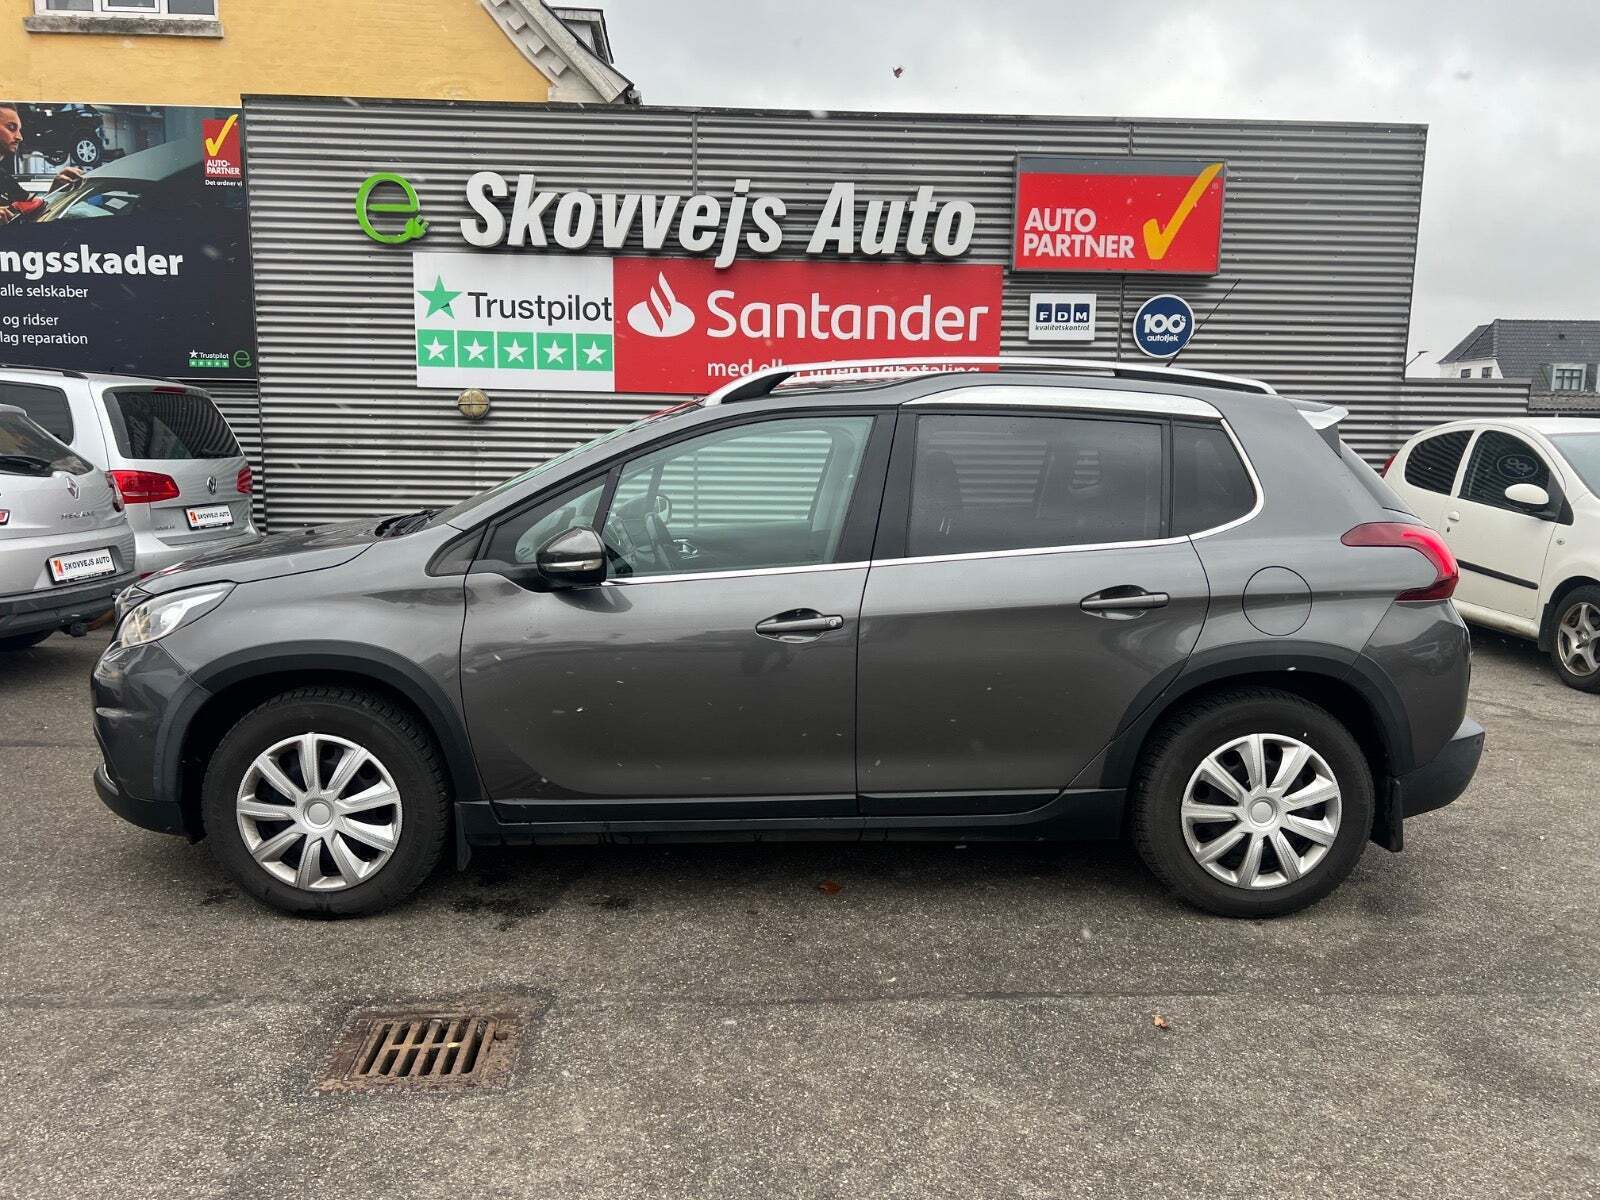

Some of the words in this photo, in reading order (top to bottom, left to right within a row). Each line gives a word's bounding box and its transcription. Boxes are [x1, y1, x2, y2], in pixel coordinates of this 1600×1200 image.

[206, 159, 231, 167] AUTO-
[206, 167, 241, 175] PARTNER
[460, 171, 787, 270] Skovvejs
[805, 182, 976, 257] Auto
[1023, 207, 1097, 233] AUTO
[1022, 233, 1136, 259] PARTNER
[0, 244, 184, 281] ngsskader
[0, 283, 24, 297] alle
[26, 284, 89, 298] selskaber
[467, 291, 613, 326] Trustpilot
[706, 289, 990, 342] Santander
[2, 315, 20, 328] og
[22, 313, 59, 326] ridser
[22, 332, 88, 346] reparation
[1146, 334, 1179, 343] autotjek
[199, 352, 229, 360] Trustpilot
[707, 358, 753, 377] med
[64, 558, 95, 571] SKOVVEJS
[95, 556, 111, 565] AUTO
